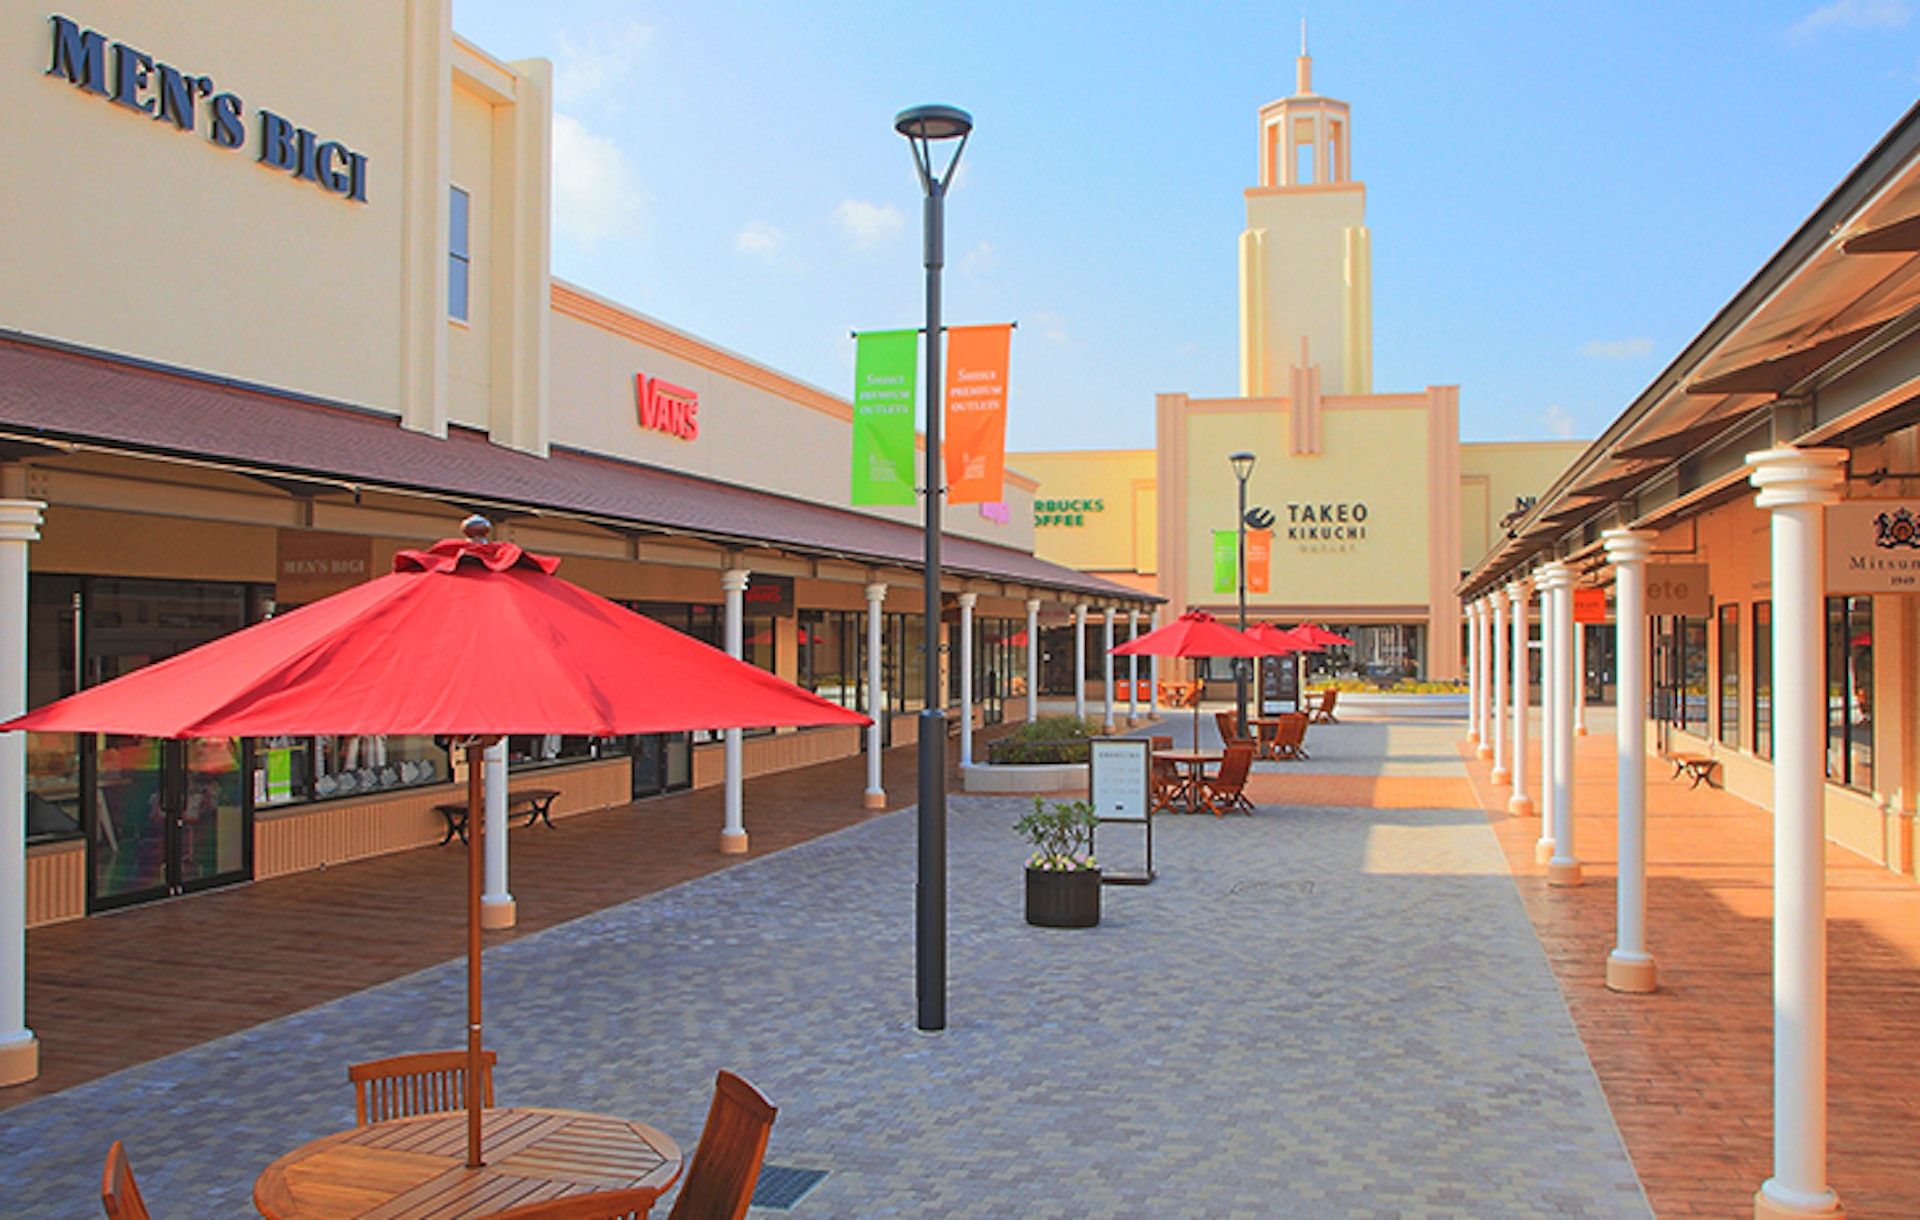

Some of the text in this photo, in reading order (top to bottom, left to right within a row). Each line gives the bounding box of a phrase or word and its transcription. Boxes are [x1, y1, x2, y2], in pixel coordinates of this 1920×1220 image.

[46, 15, 368, 203] MEN'S BIGI
[636, 372, 699, 441] VANS
[1287, 504, 1368, 523] TAKEO
[1288, 527, 1366, 539] KIKUCHI
